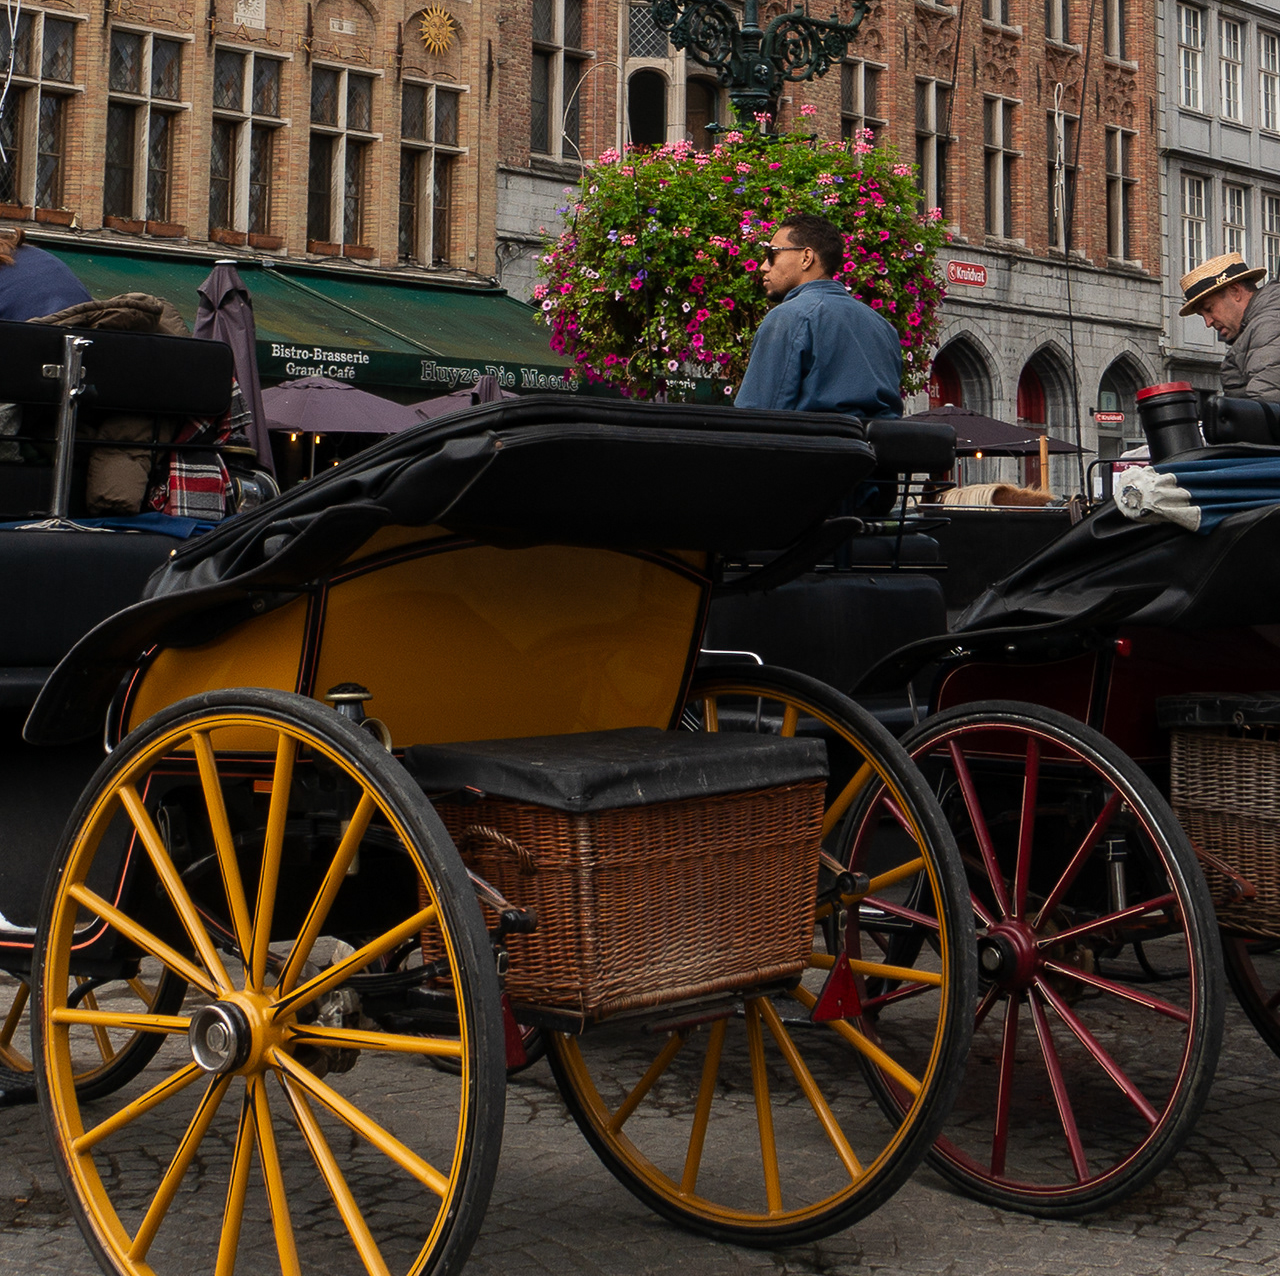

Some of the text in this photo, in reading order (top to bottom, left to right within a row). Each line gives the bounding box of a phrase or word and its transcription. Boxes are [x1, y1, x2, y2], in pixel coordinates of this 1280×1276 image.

[956, 266, 985, 283] Kruidvat
[271, 343, 370, 364] Bistro-Brasserie
[285, 362, 356, 380] Grand-Café
[420, 360, 580, 392] Huyze Die Maene
